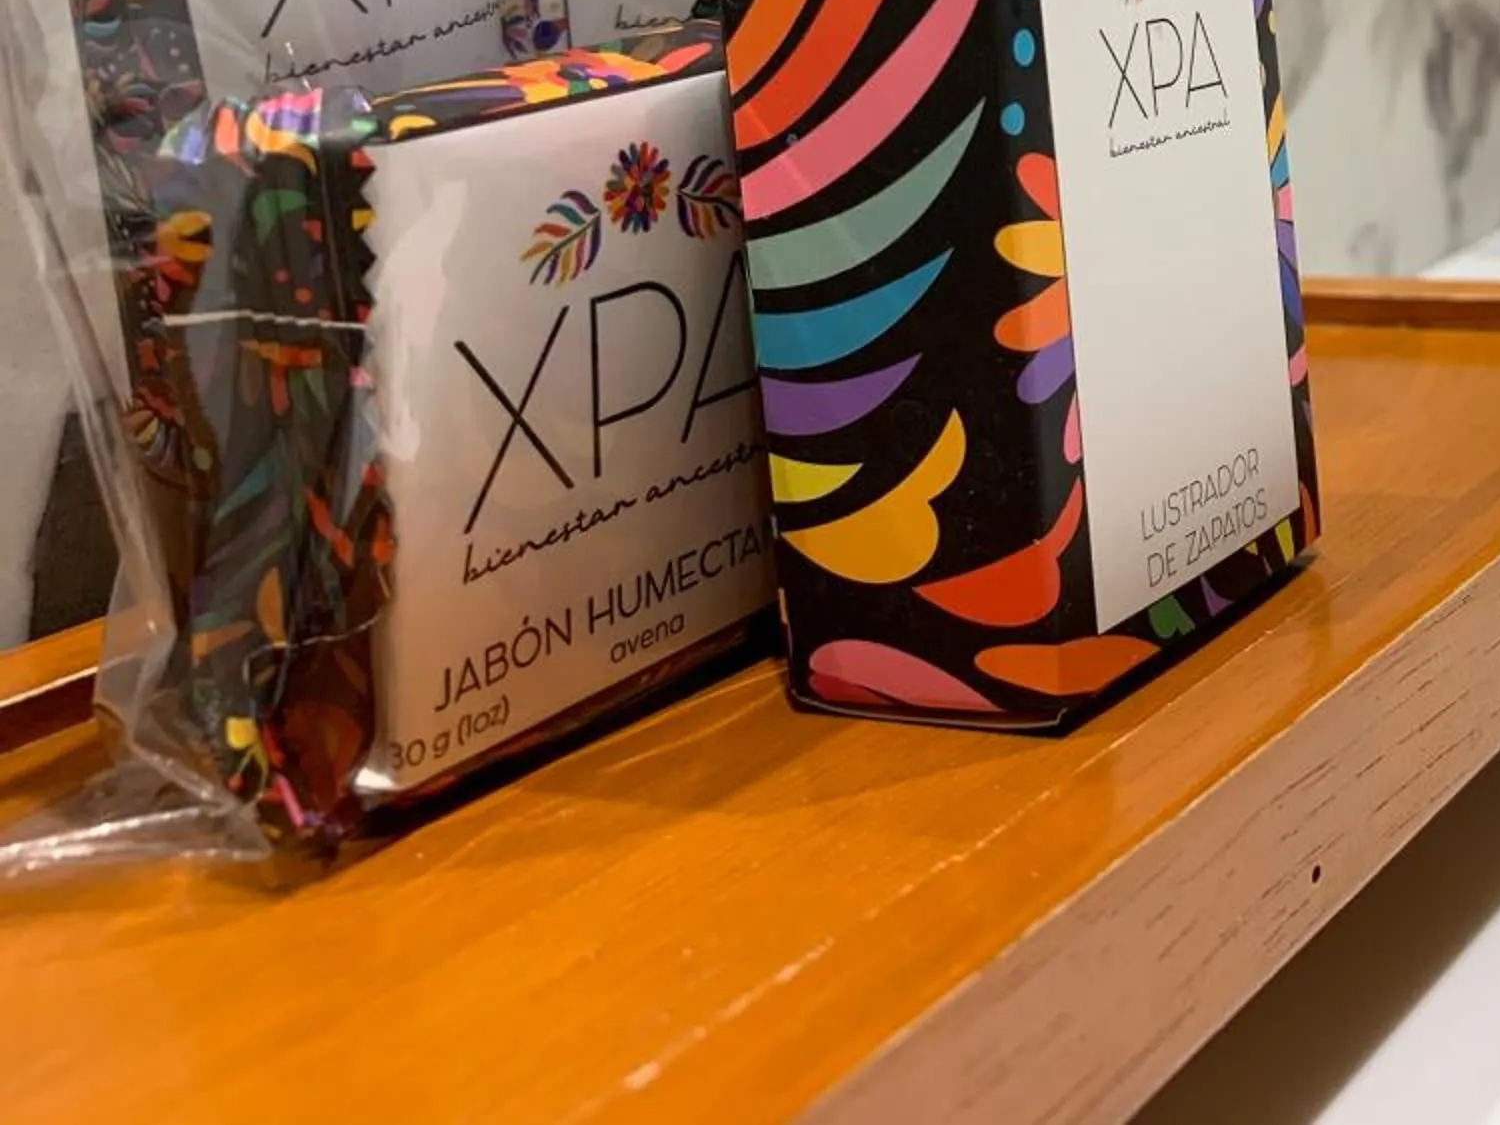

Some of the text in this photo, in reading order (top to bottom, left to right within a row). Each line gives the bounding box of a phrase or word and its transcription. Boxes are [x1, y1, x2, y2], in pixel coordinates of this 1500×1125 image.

[263, 33, 427, 84] bienestar
[1099, 11, 1229, 129] XPA
[453, 248, 760, 536] XPA
[462, 491, 638, 586] bienestar
[1140, 447, 1260, 542] LUSTRADOR
[1146, 487, 1268, 588] DE ZAPATOS
[433, 517, 772, 713] JABÓN HUMECTA
[609, 612, 686, 665] avena
[432, 729, 453, 759] g
[456, 693, 511, 747] (1oz)
